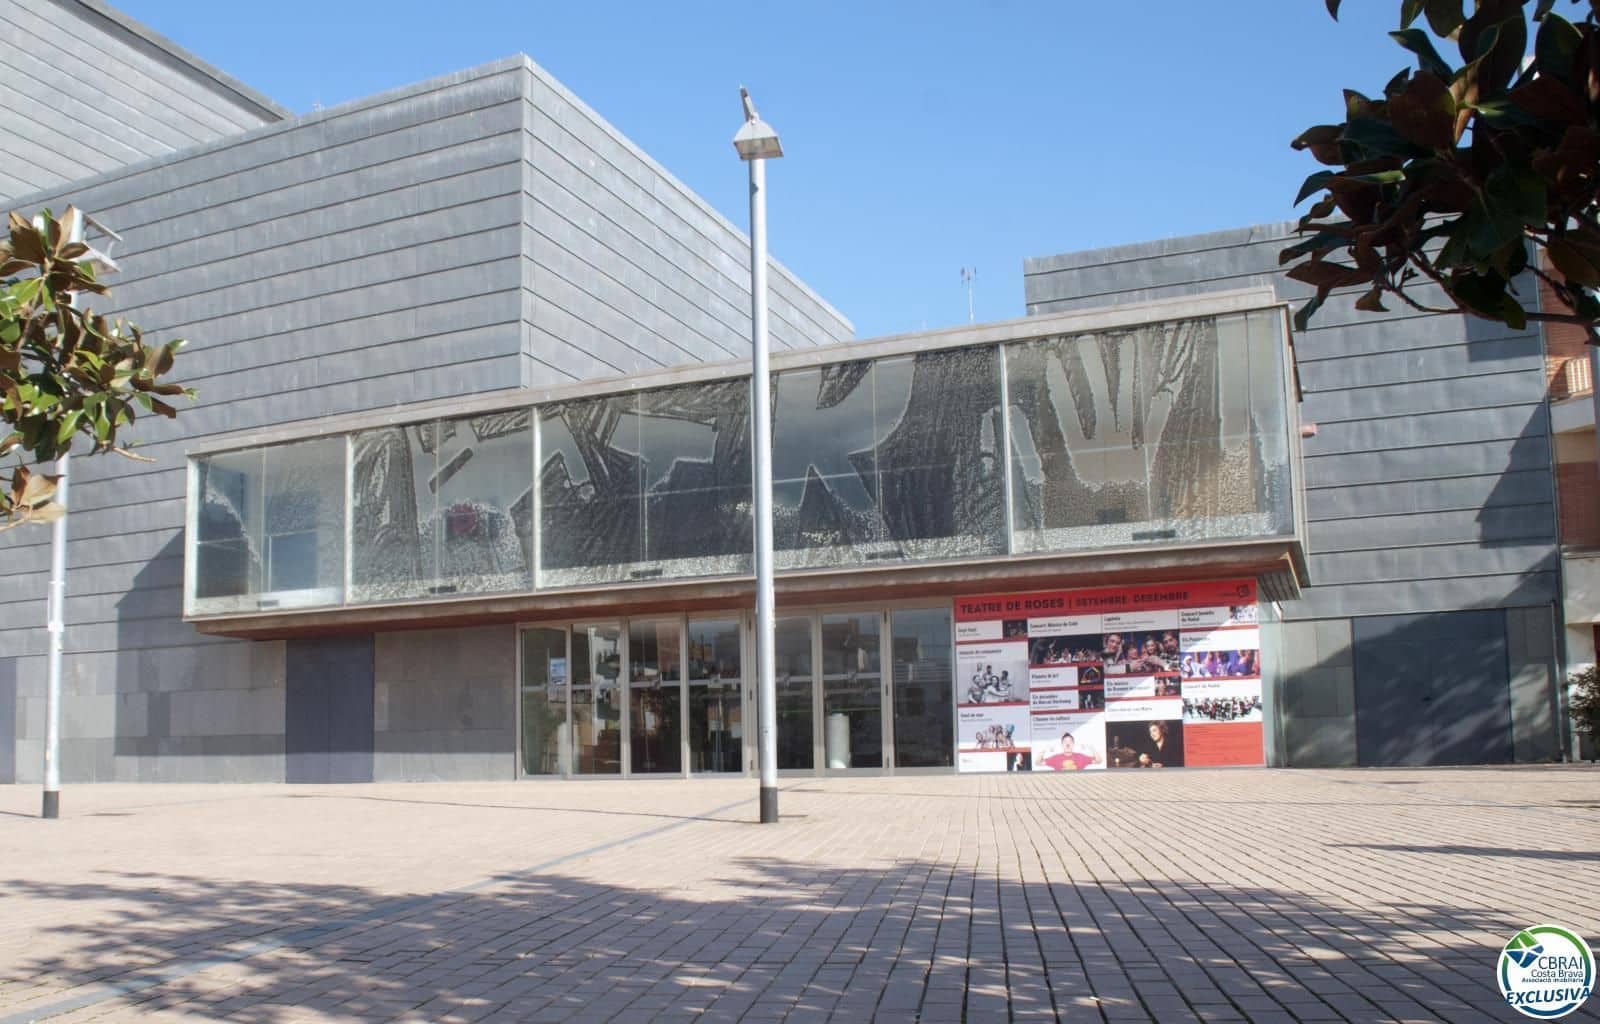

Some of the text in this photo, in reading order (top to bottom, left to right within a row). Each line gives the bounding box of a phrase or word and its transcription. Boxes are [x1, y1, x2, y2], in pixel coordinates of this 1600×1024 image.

[960, 602, 1002, 614] TEATRE
[1006, 601, 1021, 611] DE
[1025, 598, 1065, 610] ROSES
